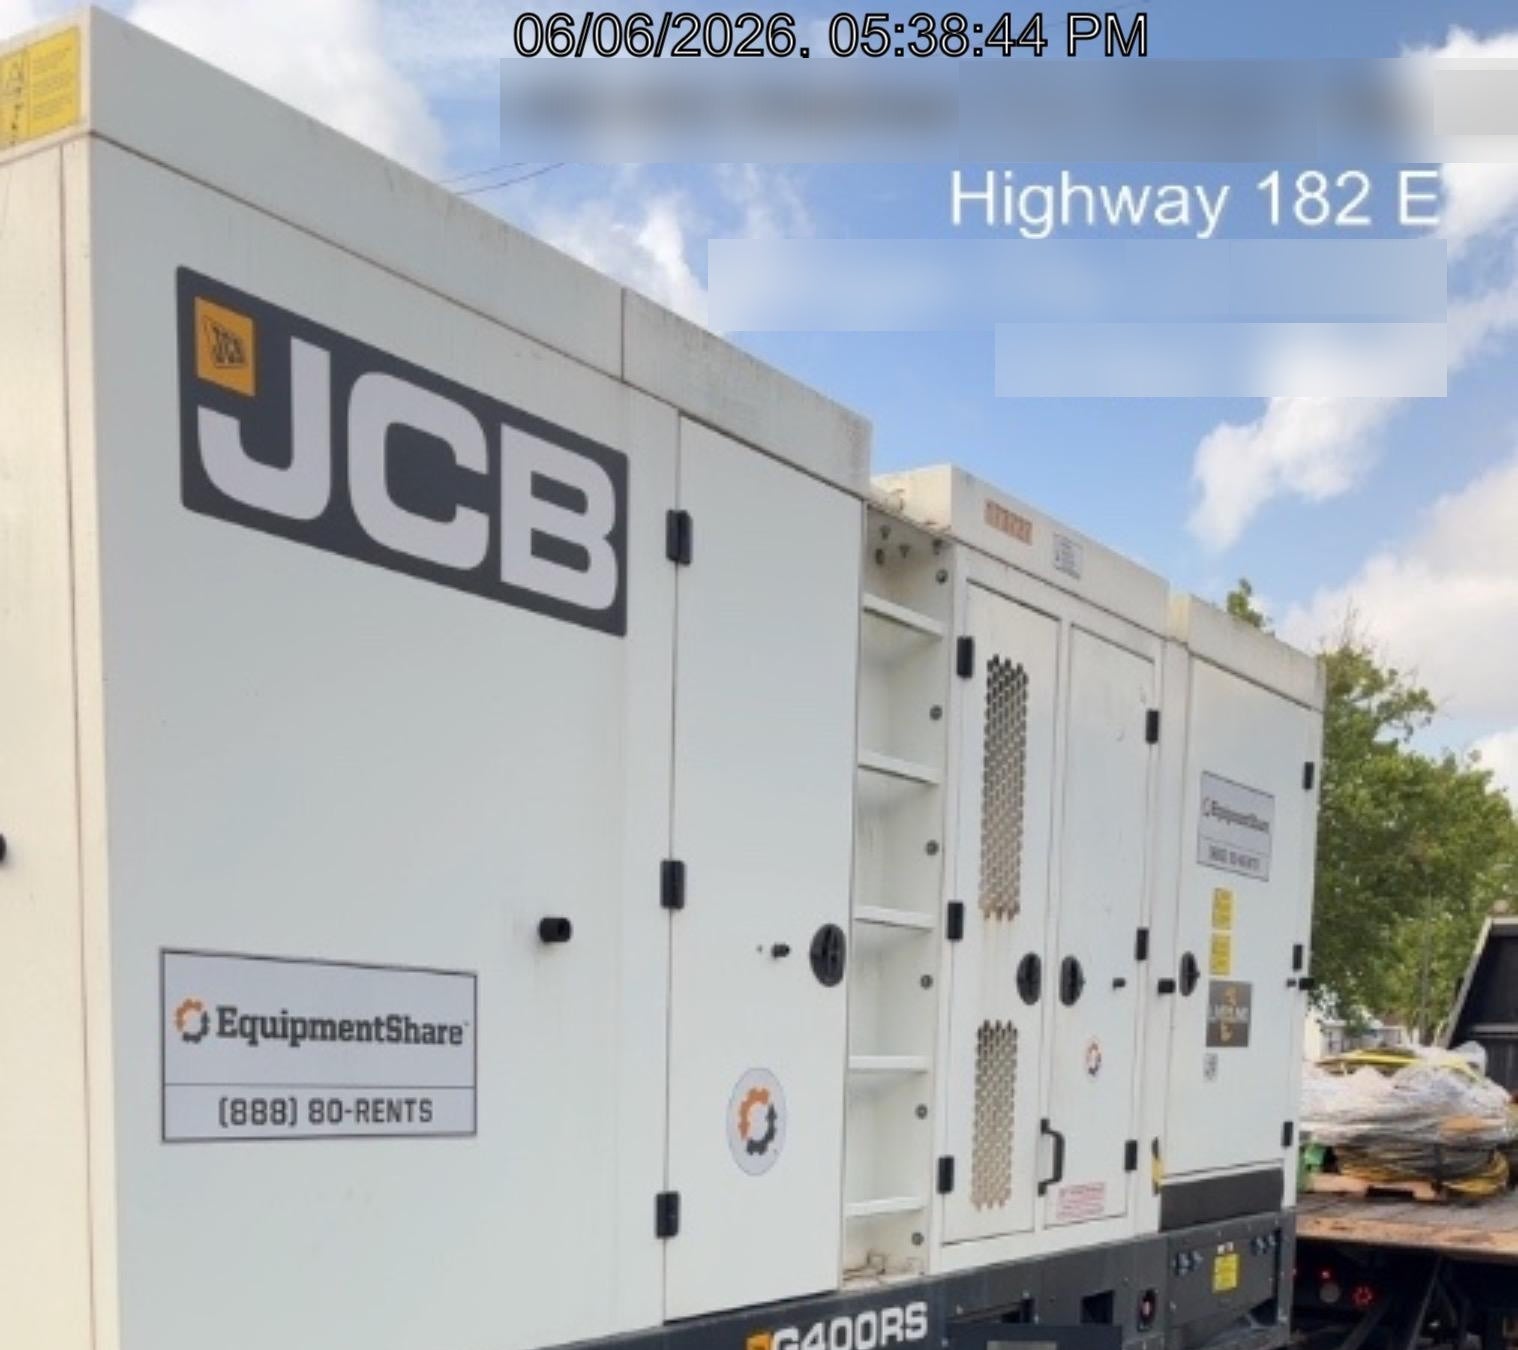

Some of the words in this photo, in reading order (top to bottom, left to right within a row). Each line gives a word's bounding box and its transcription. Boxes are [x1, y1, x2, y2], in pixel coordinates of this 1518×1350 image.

[197, 336, 618, 611] JCB
[216, 1005, 464, 1047] EquipmentShare
[218, 1096, 298, 1128] (888)
[308, 1098, 433, 1125] 80-RENTS
